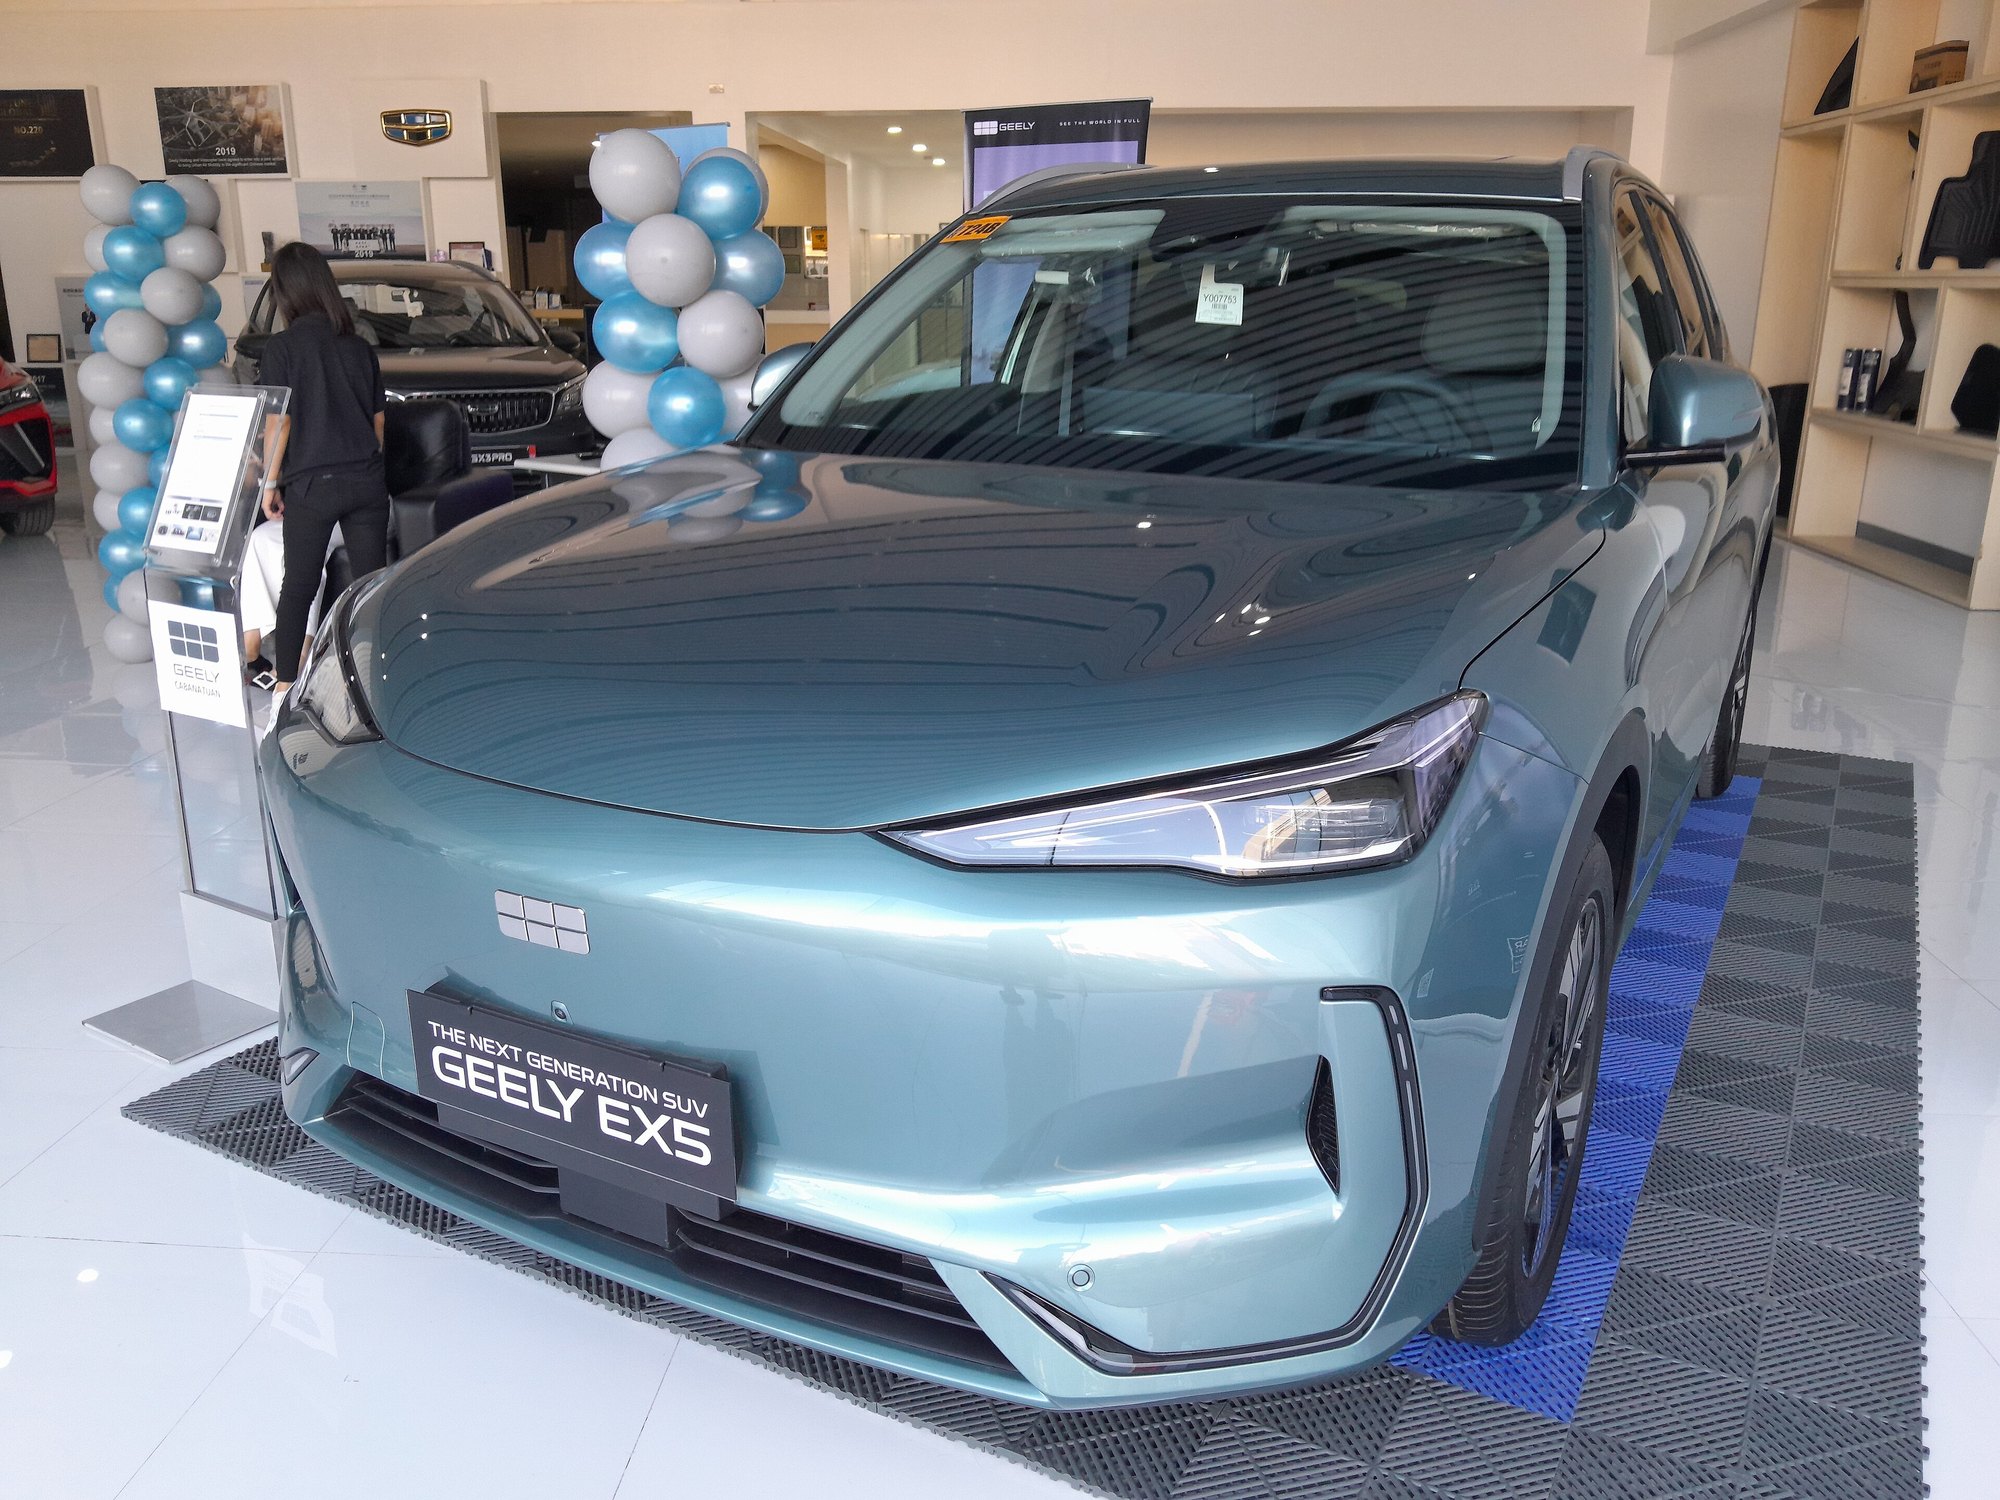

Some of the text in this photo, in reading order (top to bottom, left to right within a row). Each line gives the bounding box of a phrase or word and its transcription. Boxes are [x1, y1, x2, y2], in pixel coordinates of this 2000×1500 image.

[999, 121, 1036, 132] GEELY
[215, 147, 236, 156] 2019
[355, 250, 374, 258] 2019
[173, 663, 220, 683] GEELY
[428, 1020, 708, 1118] THE NEXT GENERATION SUV
[431, 1045, 712, 1166] GEELY EX5
